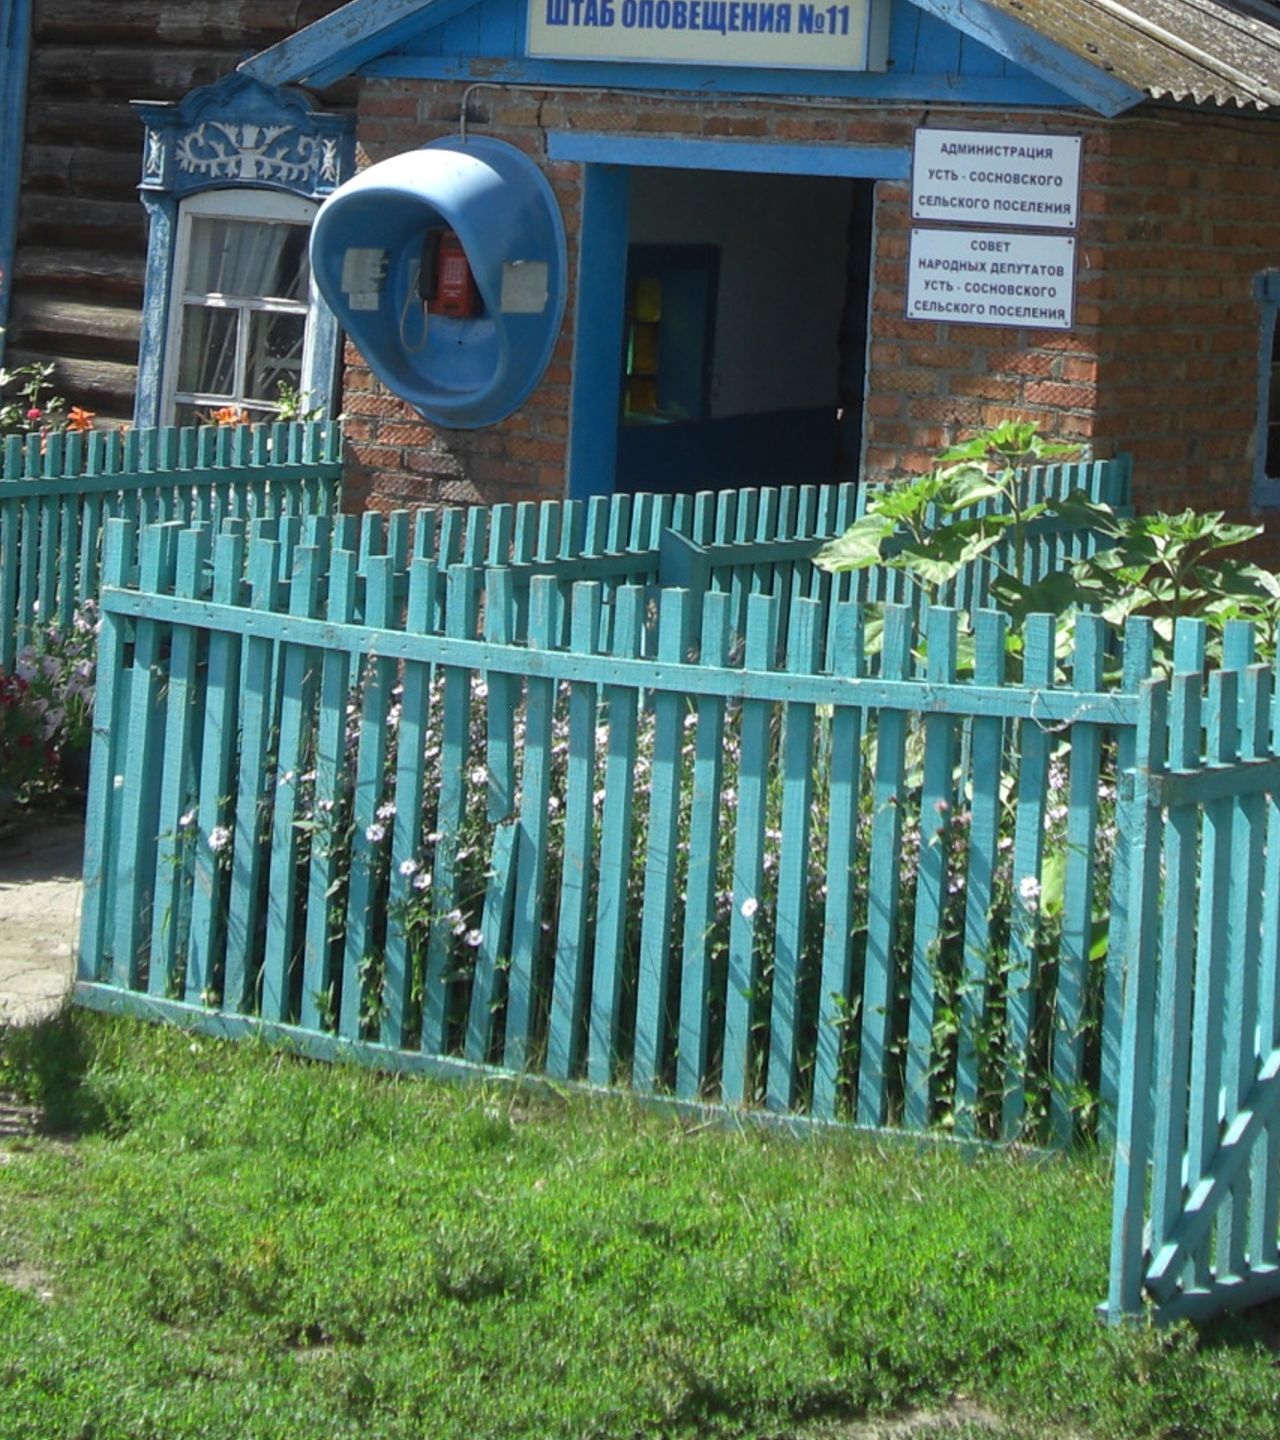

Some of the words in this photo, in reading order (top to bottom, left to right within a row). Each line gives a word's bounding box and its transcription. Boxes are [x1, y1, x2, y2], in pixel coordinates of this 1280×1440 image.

[797, 3, 850, 36] №11
[940, 142, 1053, 160] АДМИНИСТРАЦИЯ
[927, 168, 959, 181] УСТЬ
[969, 170, 1063, 187] СОСНОВСКОГО
[918, 194, 990, 210] СЕЛЬСКОГО
[993, 199, 1071, 215] ПОСЕЛЕНИЯ
[970, 239, 1012, 253] СОВЕТ
[918, 258, 986, 273] НАРОДНЫХ
[989, 262, 1064, 277] ДЕПУТАТОВ
[923, 279, 954, 292] УСТЬ
[964, 282, 1057, 298] СОСНОВСКОГО
[913, 300, 985, 316] СЕЛЬСКОГО
[989, 304, 1065, 320] ПОСЕЛЕНИЯ
